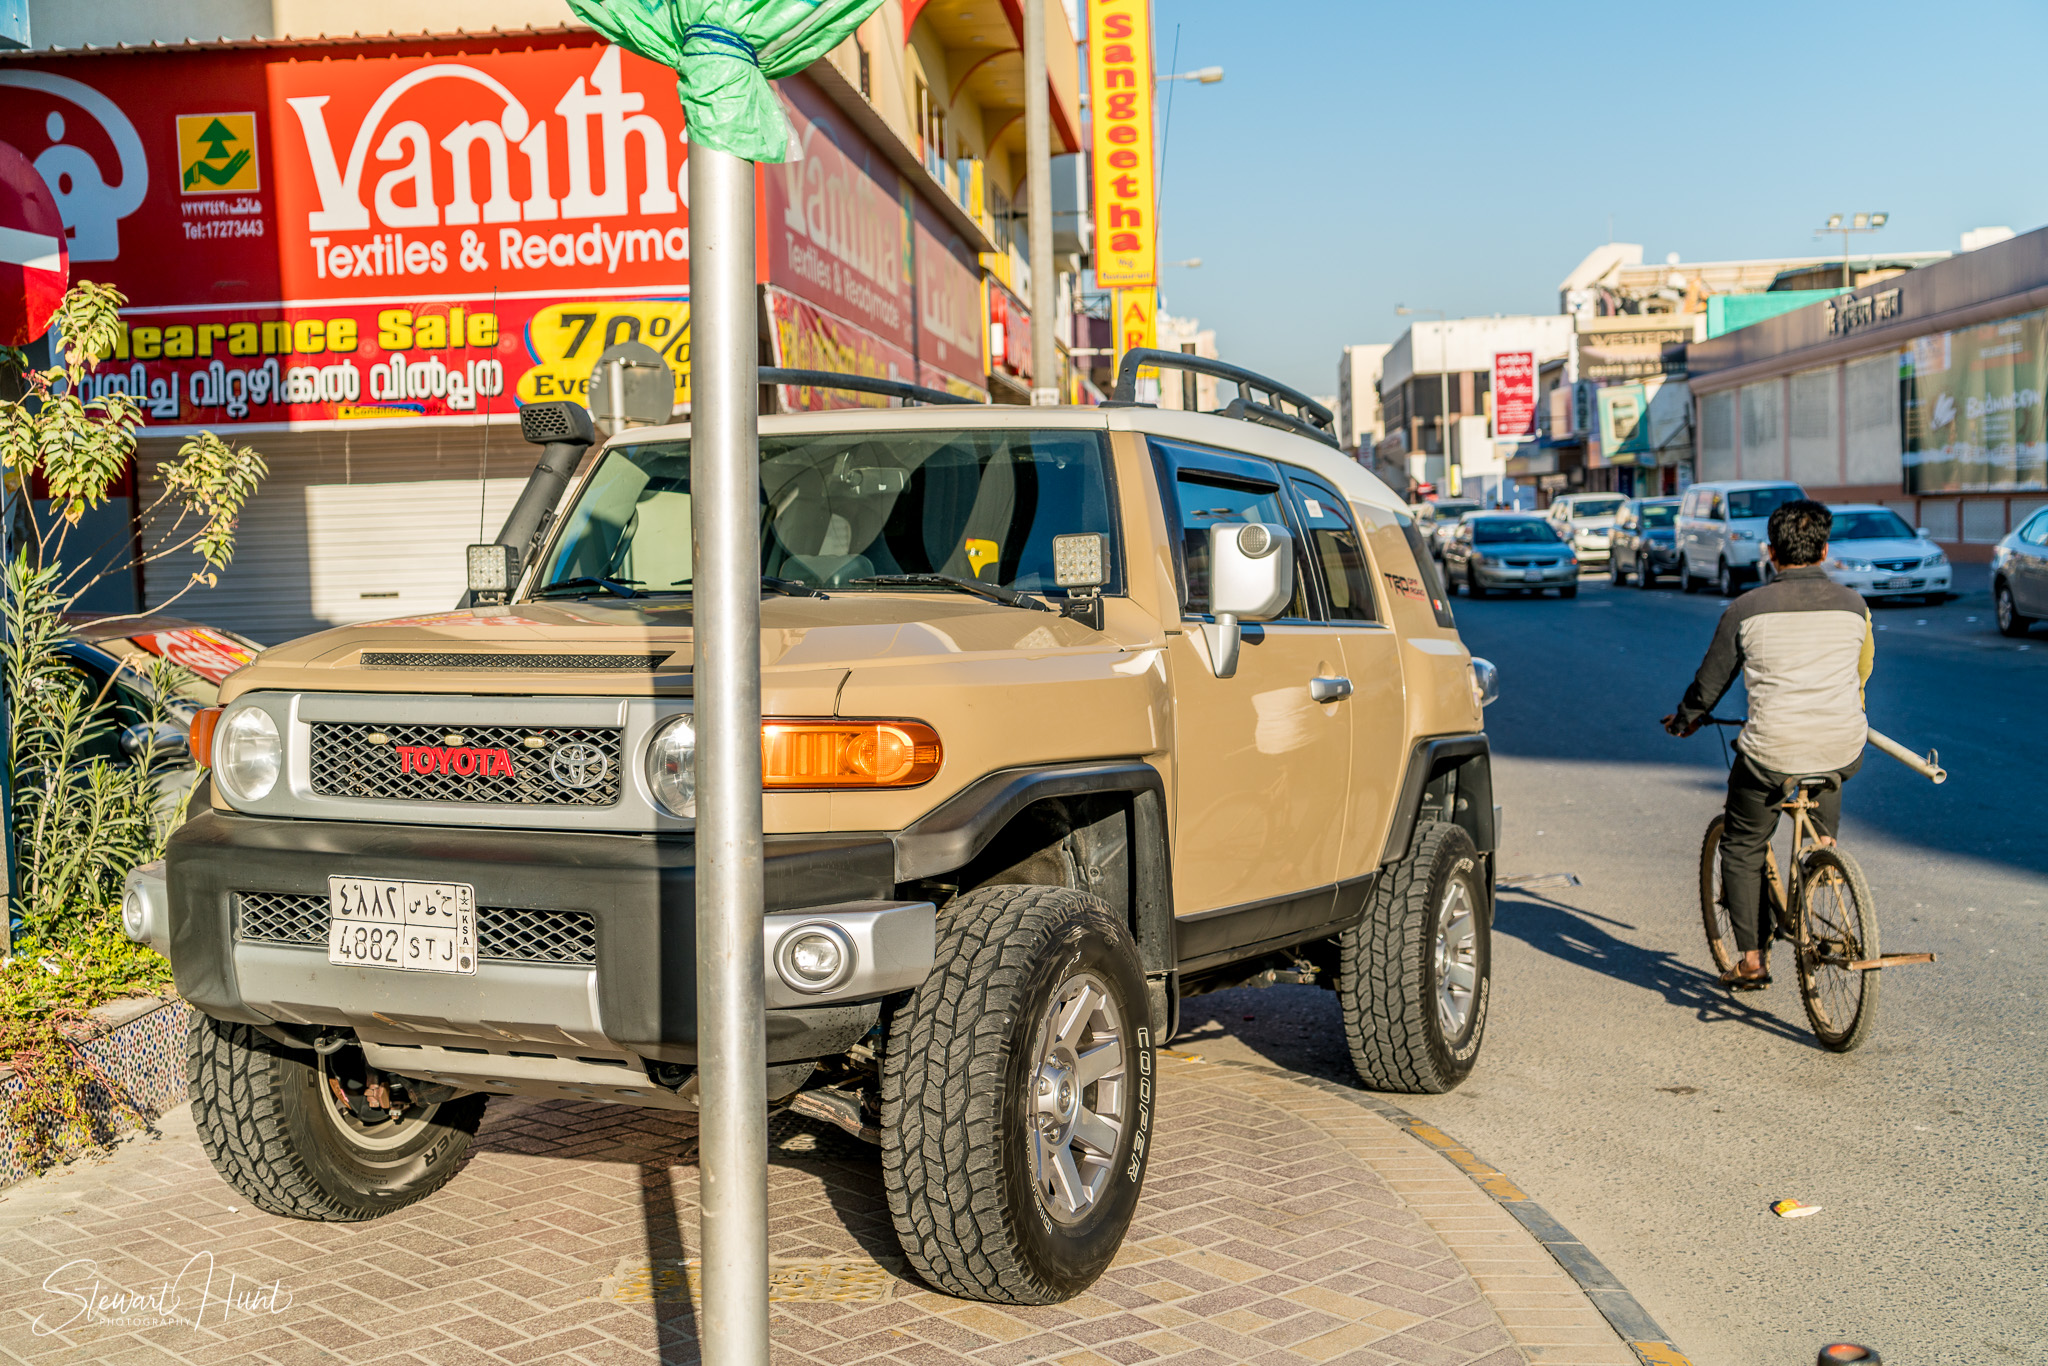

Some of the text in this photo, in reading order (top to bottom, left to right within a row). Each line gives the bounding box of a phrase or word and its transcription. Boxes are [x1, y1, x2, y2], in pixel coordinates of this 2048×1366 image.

[1104, 14, 1140, 252] Sangeetha
[182, 220, 264, 240] Tel:17273443
[310, 222, 690, 279] Textiles & Readyma
[785, 232, 831, 291] Textiles
[94, 306, 500, 363] learance Sale
[396, 746, 515, 778] TOYOTA
[340, 926, 399, 963] 4882
[1126, 1027, 1152, 1184] COOPER
